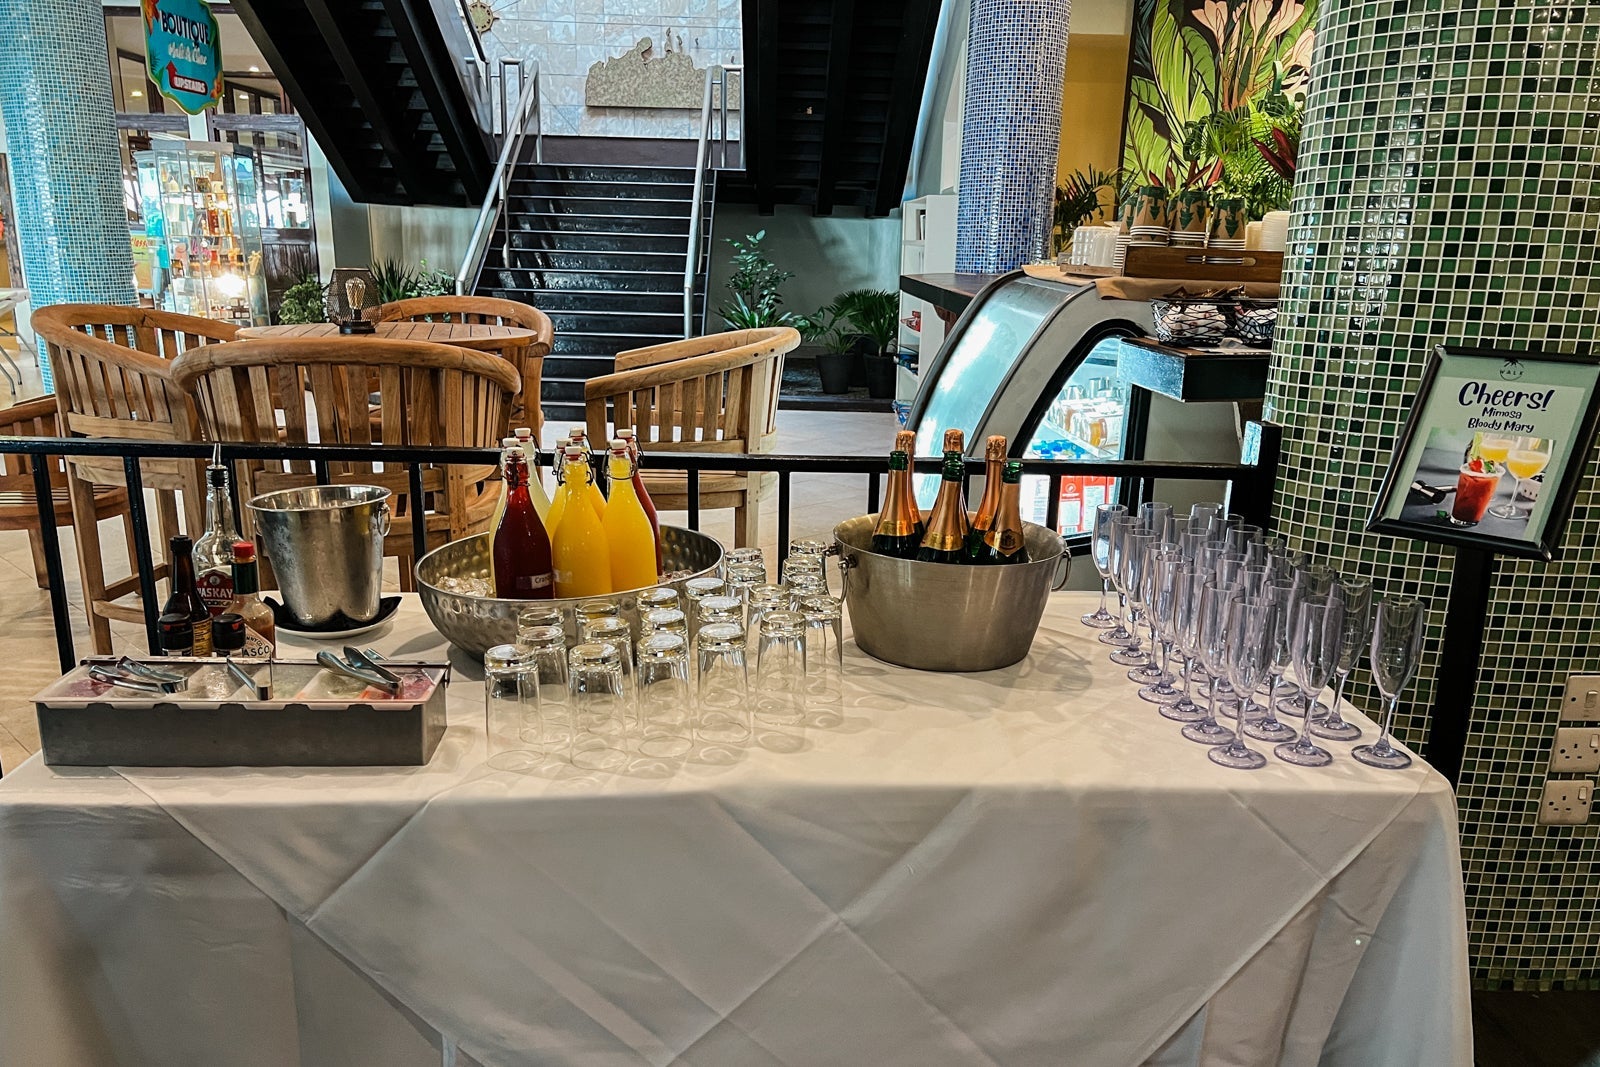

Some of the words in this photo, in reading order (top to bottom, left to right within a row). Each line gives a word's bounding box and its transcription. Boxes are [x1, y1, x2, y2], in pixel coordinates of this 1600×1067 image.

[160, 10, 210, 46] BOUTIQUE
[173, 76, 206, 93] UPSTAIRS
[1458, 381, 1556, 411] Cheers!
[1482, 406, 1522, 419] Mimosa
[1468, 417, 1502, 431] Bloody
[1504, 420, 1534, 433] Mary
